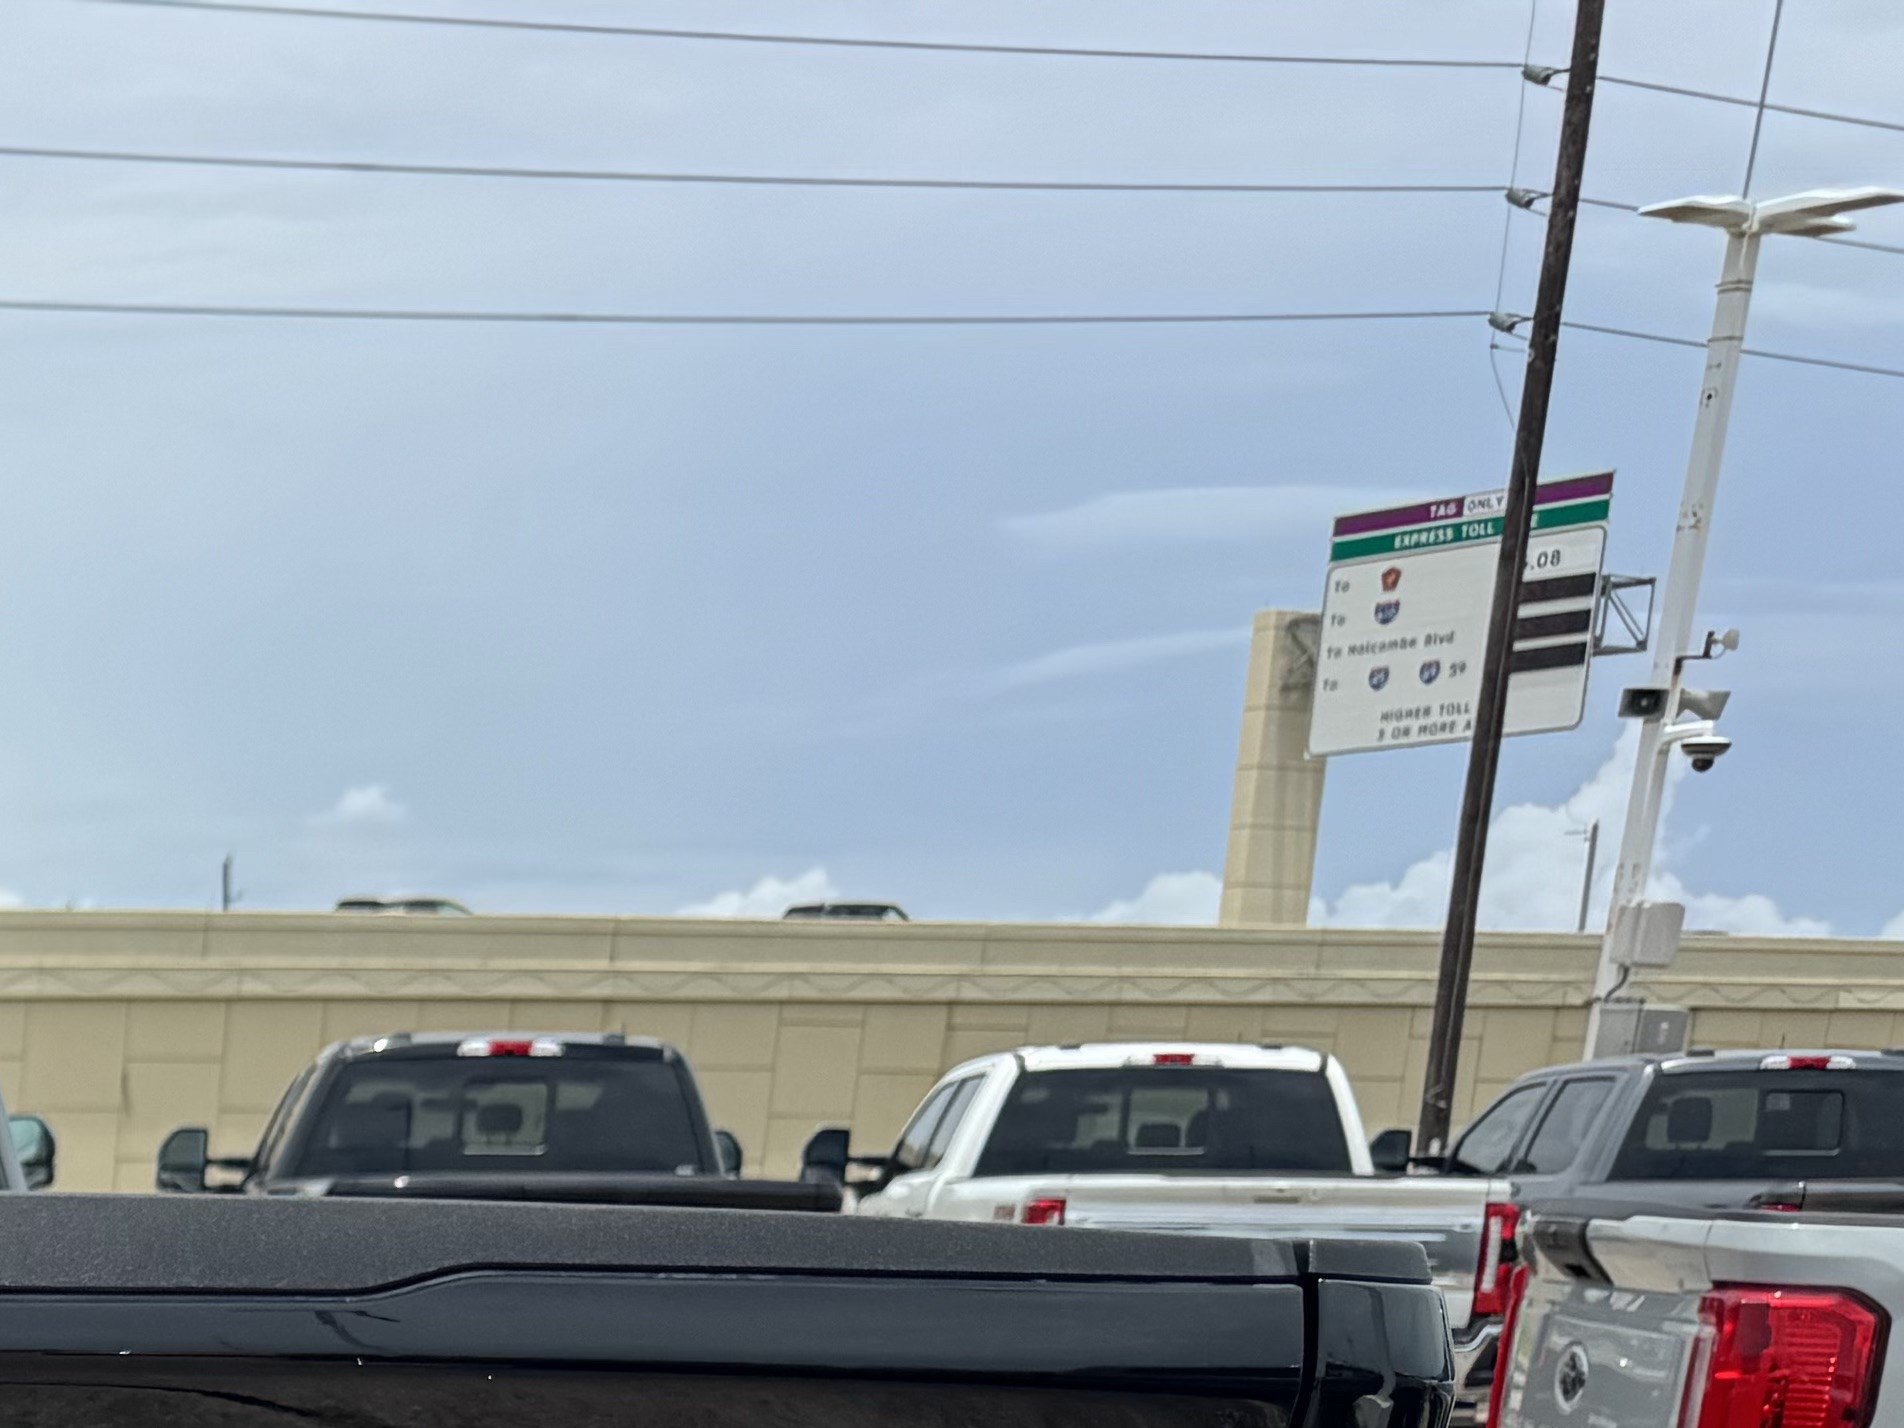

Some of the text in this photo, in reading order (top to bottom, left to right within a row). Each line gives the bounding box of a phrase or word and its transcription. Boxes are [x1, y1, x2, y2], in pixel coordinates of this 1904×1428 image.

[1429, 495, 1505, 519] TAG ONLY
[1393, 521, 1494, 550] EXPRESS TOLL
[1424, 630, 1455, 647] Blvd
